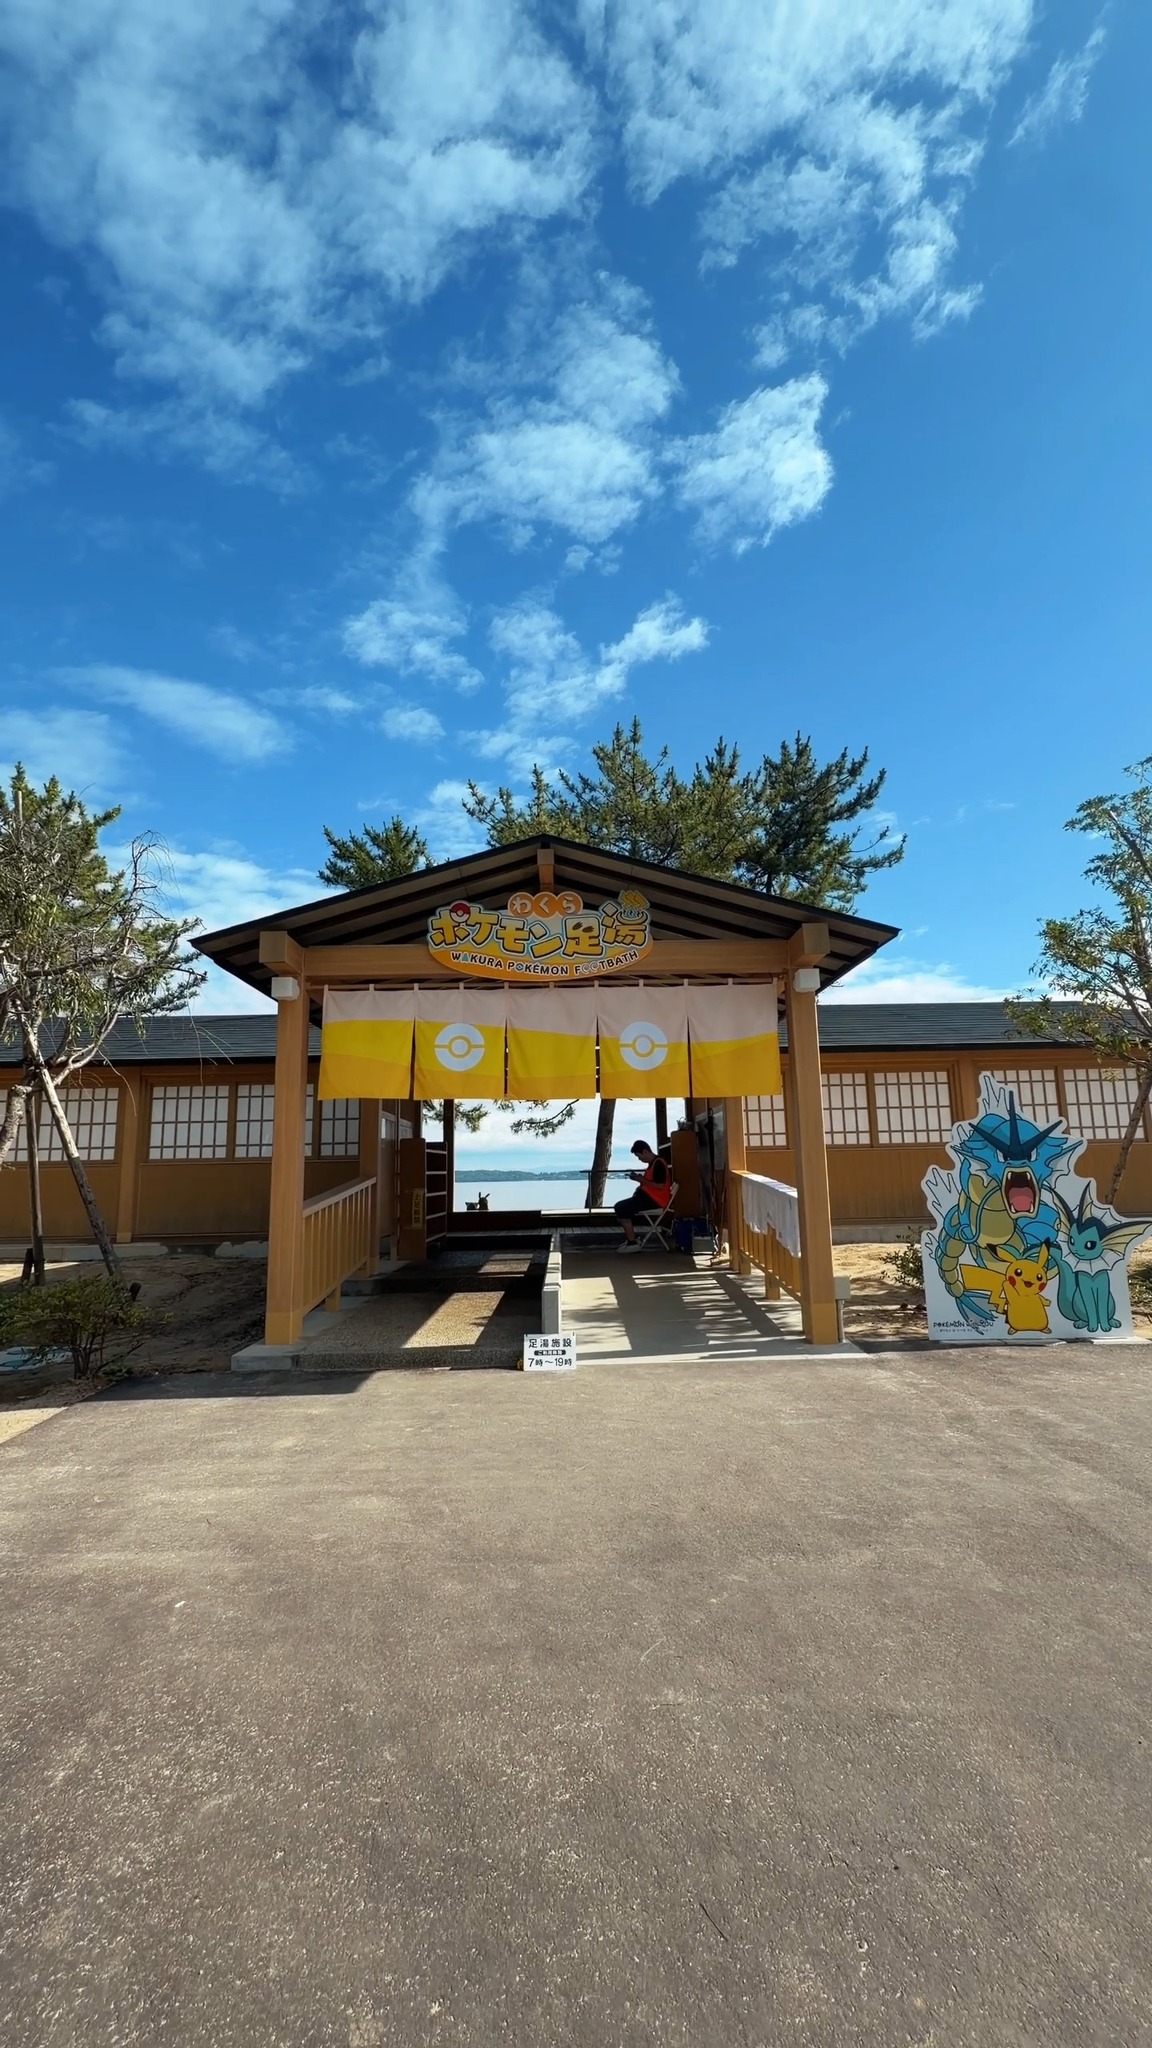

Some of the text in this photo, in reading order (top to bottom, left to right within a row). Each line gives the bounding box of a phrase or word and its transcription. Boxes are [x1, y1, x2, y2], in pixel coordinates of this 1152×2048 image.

[510, 897, 577, 914] わくら
[430, 893, 649, 957] ポケモン足湯
[451, 951, 638, 976] WAKURA POKÉMON FOOTBATH
[528, 1338, 572, 1348] 足湯施設
